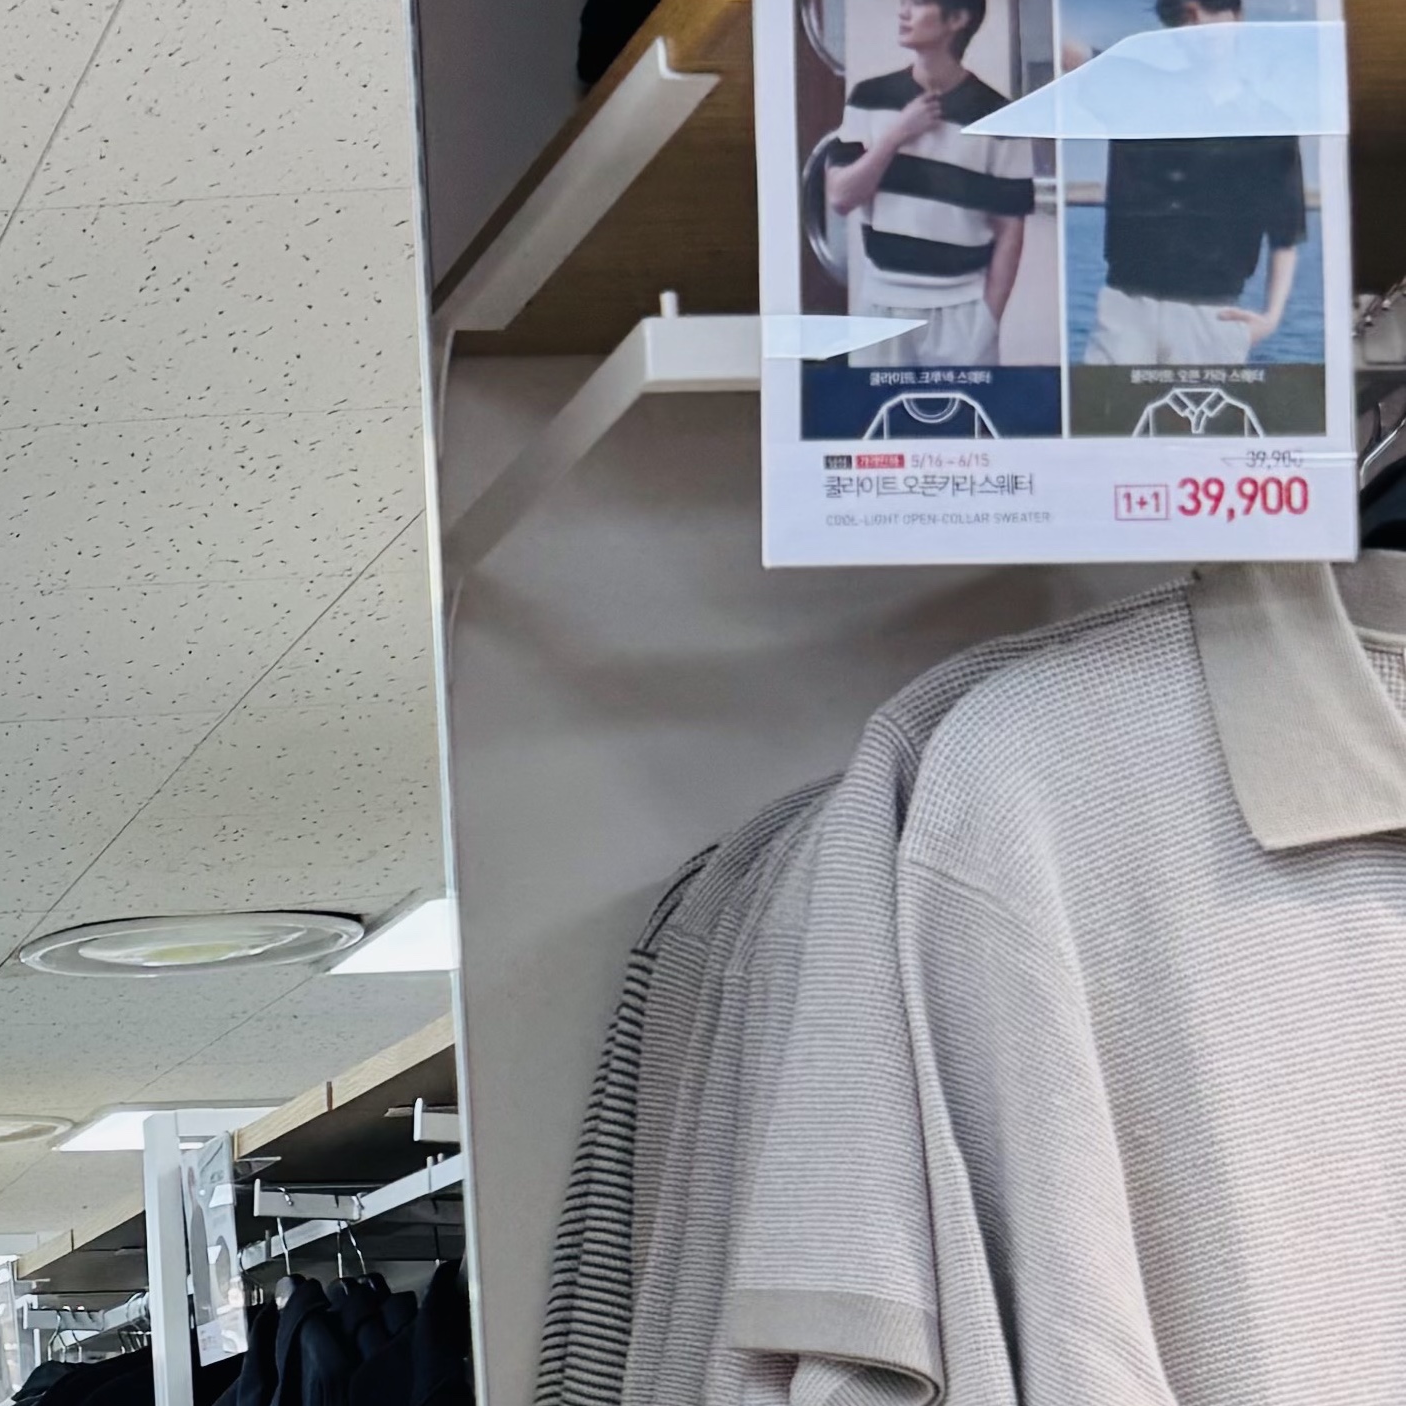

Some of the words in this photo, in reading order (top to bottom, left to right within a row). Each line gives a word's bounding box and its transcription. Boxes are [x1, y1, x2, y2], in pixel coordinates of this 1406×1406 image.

[911, 454, 943, 469] 5/16
[958, 453, 990, 468] 6/15
[824, 475, 899, 498] 쿨라이트
[978, 472, 1034, 496] 스웨터
[1123, 491, 1160, 513] 1+1
[1177, 476, 1309, 522] 39,900
[993, 511, 1051, 523] SWEATER
